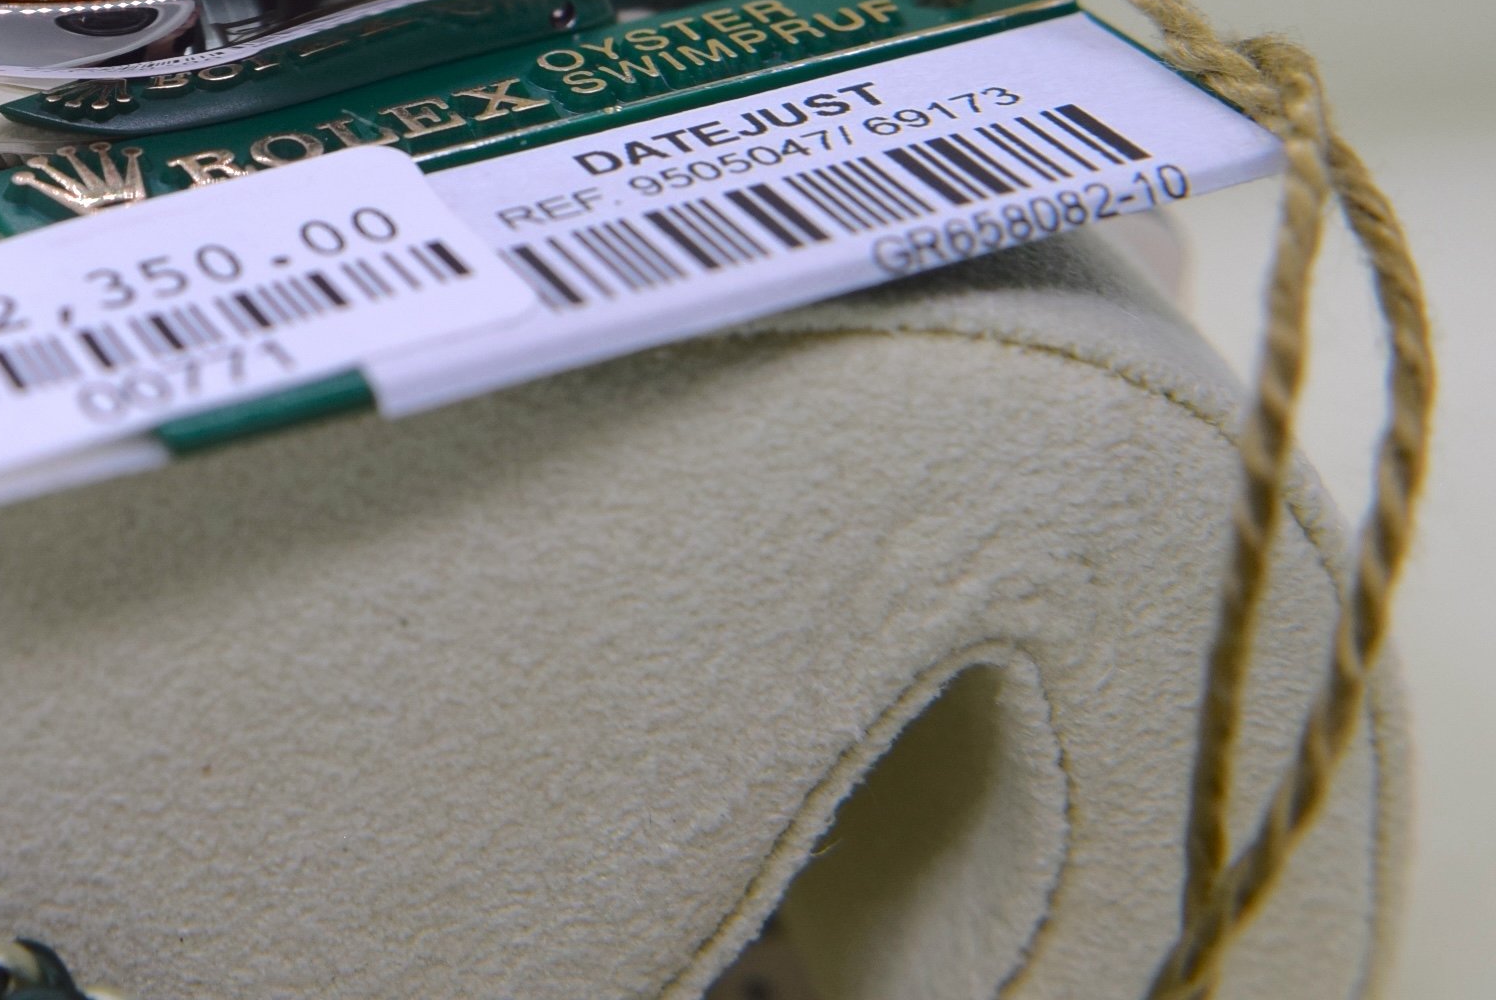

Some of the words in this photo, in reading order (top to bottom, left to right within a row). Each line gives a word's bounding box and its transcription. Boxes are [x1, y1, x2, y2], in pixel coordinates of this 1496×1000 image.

[537, 0, 797, 72] OYSTER
[166, 77, 551, 190] ROLEX
[497, 186, 620, 232] REF.
[862, 86, 1022, 138] 69173
[571, 81, 885, 176] DATEJUST
[871, 164, 1190, 276] GR658082-10
[77, 337, 297, 426] 00771
